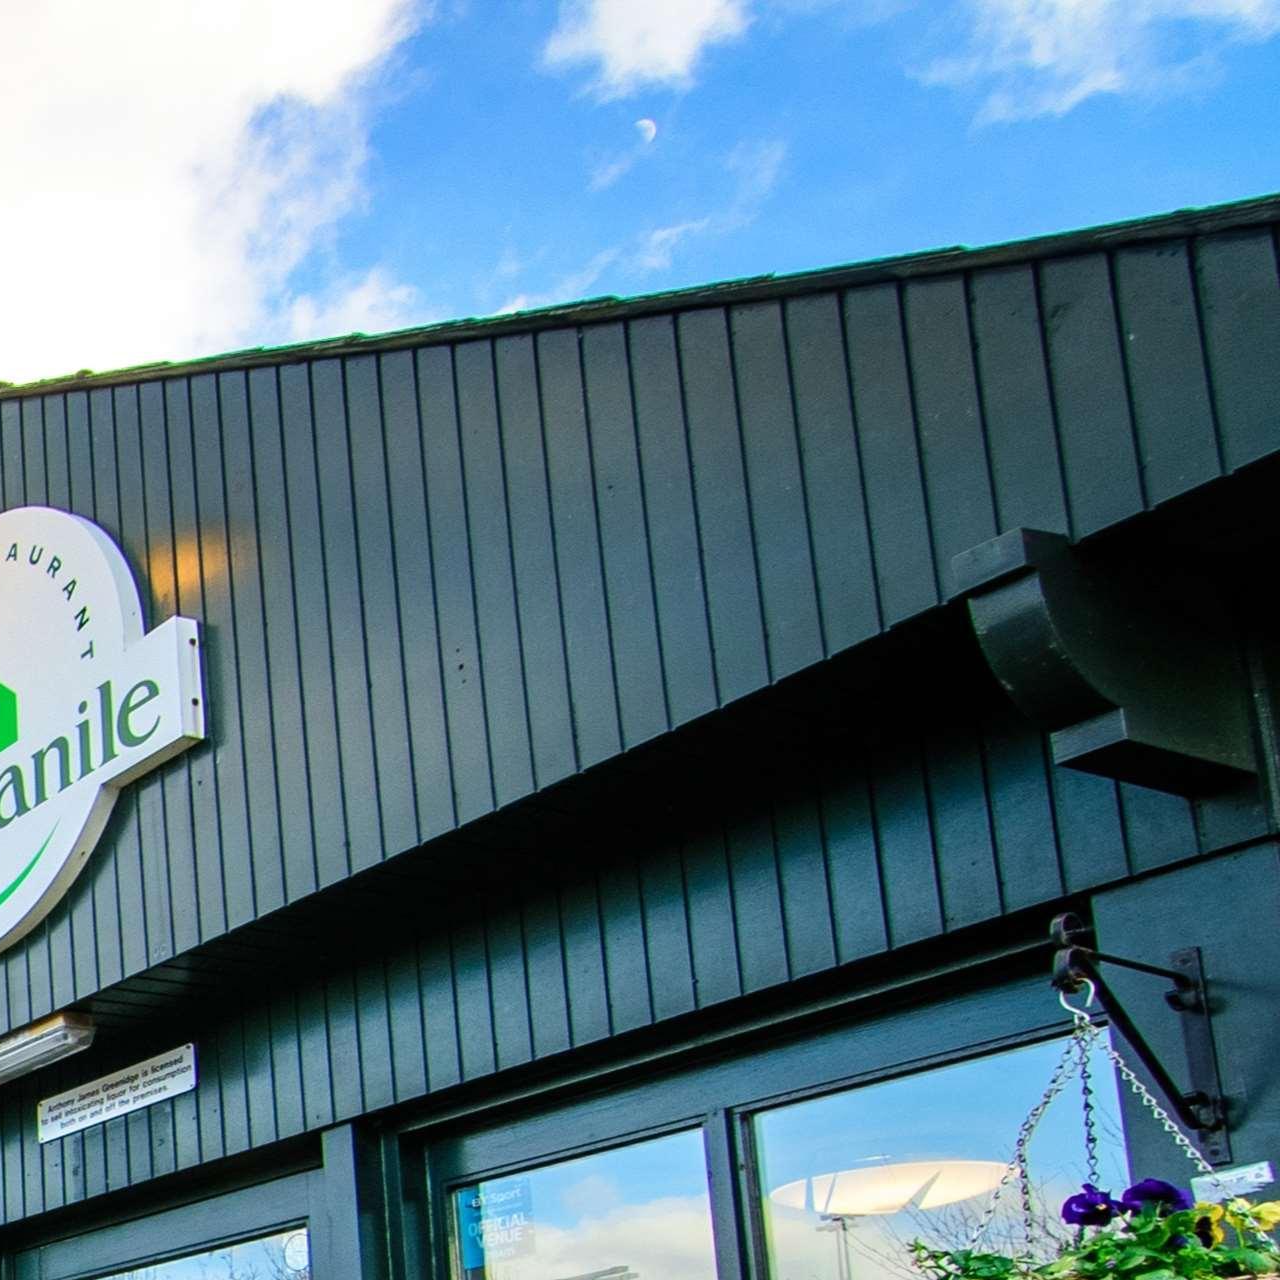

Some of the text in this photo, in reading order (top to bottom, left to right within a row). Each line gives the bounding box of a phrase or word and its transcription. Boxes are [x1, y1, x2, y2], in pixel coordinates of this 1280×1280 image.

[65, 1098, 103, 1116] intoxicating
[107, 1089, 126, 1101] liquor
[130, 1083, 139, 1092] for
[142, 1066, 191, 1087] consumption
[78, 1089, 99, 1101] James
[151, 1056, 182, 1073] licensed
